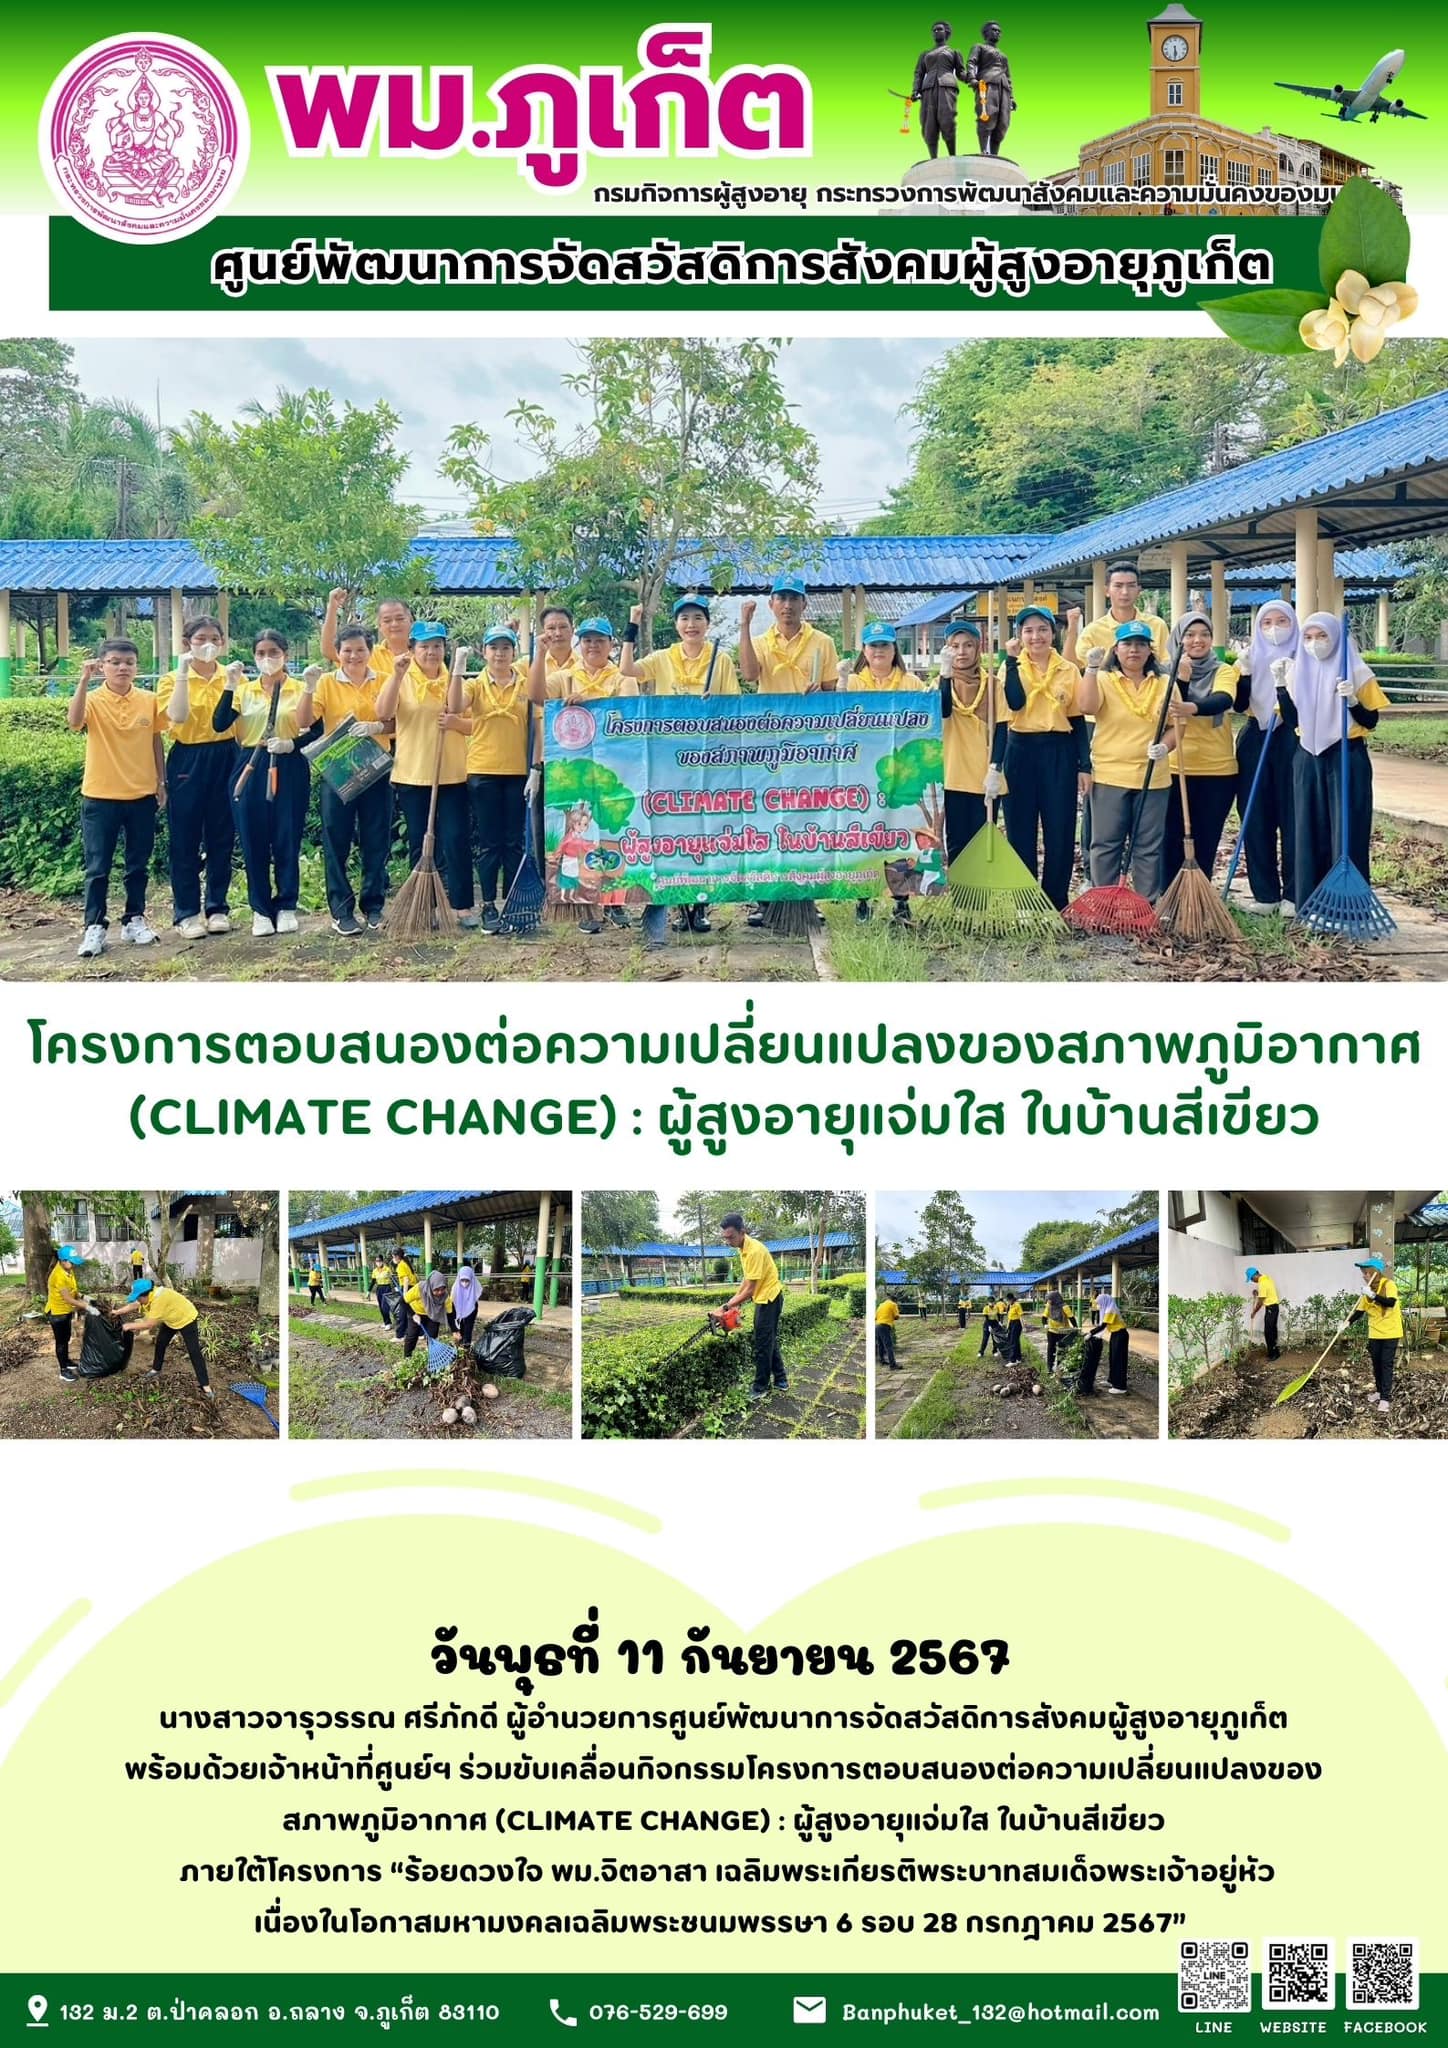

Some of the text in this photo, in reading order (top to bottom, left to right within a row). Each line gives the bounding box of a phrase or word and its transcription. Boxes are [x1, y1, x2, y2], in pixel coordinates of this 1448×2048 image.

[278, 33, 803, 186] พม.ภูเก็ต
[595, 174, 1338, 209] กรมกิจการผู้สูงอายุ กระทรวงการพัฒนาสังคมและความมั่นคงของม
[216, 239, 1268, 292] ศูนย์พัฒนาการจัดสวัสดิการสังคมผู้สูงอายุภูเก็ต
[604, 706, 929, 735] โครงการตอบสนองต่อความเปลี่ยนแปลง
[678, 740, 857, 771] ของสภาพภูมิอากาศ
[642, 789, 754, 818] (CLIMATE
[764, 785, 870, 813] CHANGE)
[620, 823, 911, 865] ผู้สูงอายุแจ่มใส ในบ้านสีเขียว
[27, 999, 1420, 1085] โครงการตอบสนองต่อความเปลี่ยนแปลงของสภาพภูมิอากาศ
[129, 1094, 372, 1140] (CLIMATE
[386, 1094, 616, 1140] CHANGE)
[659, 1086, 1005, 1157] ผู้สูงอายุแจ่มใส
[1020, 1086, 1319, 1136] ในบ้านสีเขียว
[430, 1605, 1010, 1697] วันพุธที่ 11 กันยายน 2567
[160, 1700, 1288, 1741] นางสาวจารุวรรณ ศรีภักดี ผู้อำนวยการศูนย์พัฒนาการจัดสวัสดิการสังคมผู้สูงอายุภูเก็ต
[125, 1743, 1322, 1792] พร้อมด้วยเจ้าหน้าที่ศูนย์ฯ ร่วมขับเคลื่อนกิจกรรมโครงการตอบสนองต่อความเปลี่ยนแปลงของ
[282, 1806, 487, 1843] สภาพภูมิอากาศ
[495, 1807, 633, 1834] (CLIMATE
[640, 1807, 770, 1834] CHANGE)
[794, 1803, 989, 1843] ผู้สูงอายุแจ่มใส
[997, 1803, 1165, 1832] ในบ้านสีเขียว
[179, 1852, 1275, 1894] ภายใต้โครงการ “ร้อยดวงใจ พม.จิตอาสา เฉลิมพระเกียรติพระบาทสมเด็จพระเจ้าอยู่หัว
[255, 1896, 1187, 1941] เนื่องในโอกาสมหามงคลเฉลิมพระชนมพรรษา 6 รอบ 28 กรกฎาคม 2567”
[1203, 1971, 1226, 1980] LINE
[60, 1994, 500, 2030] 132 ม.2 ต.ป่าคลอก อ.ถลาง จ.ภูเก็ต 83110
[589, 2003, 728, 2021] 076-529-699
[842, 2001, 1160, 2025] Banphuket_132@hotmail.com
[1195, 2021, 1233, 2034] LINE
[1259, 2021, 1327, 2034] WEBSITE
[1343, 2021, 1428, 2034] FACEBOOK
